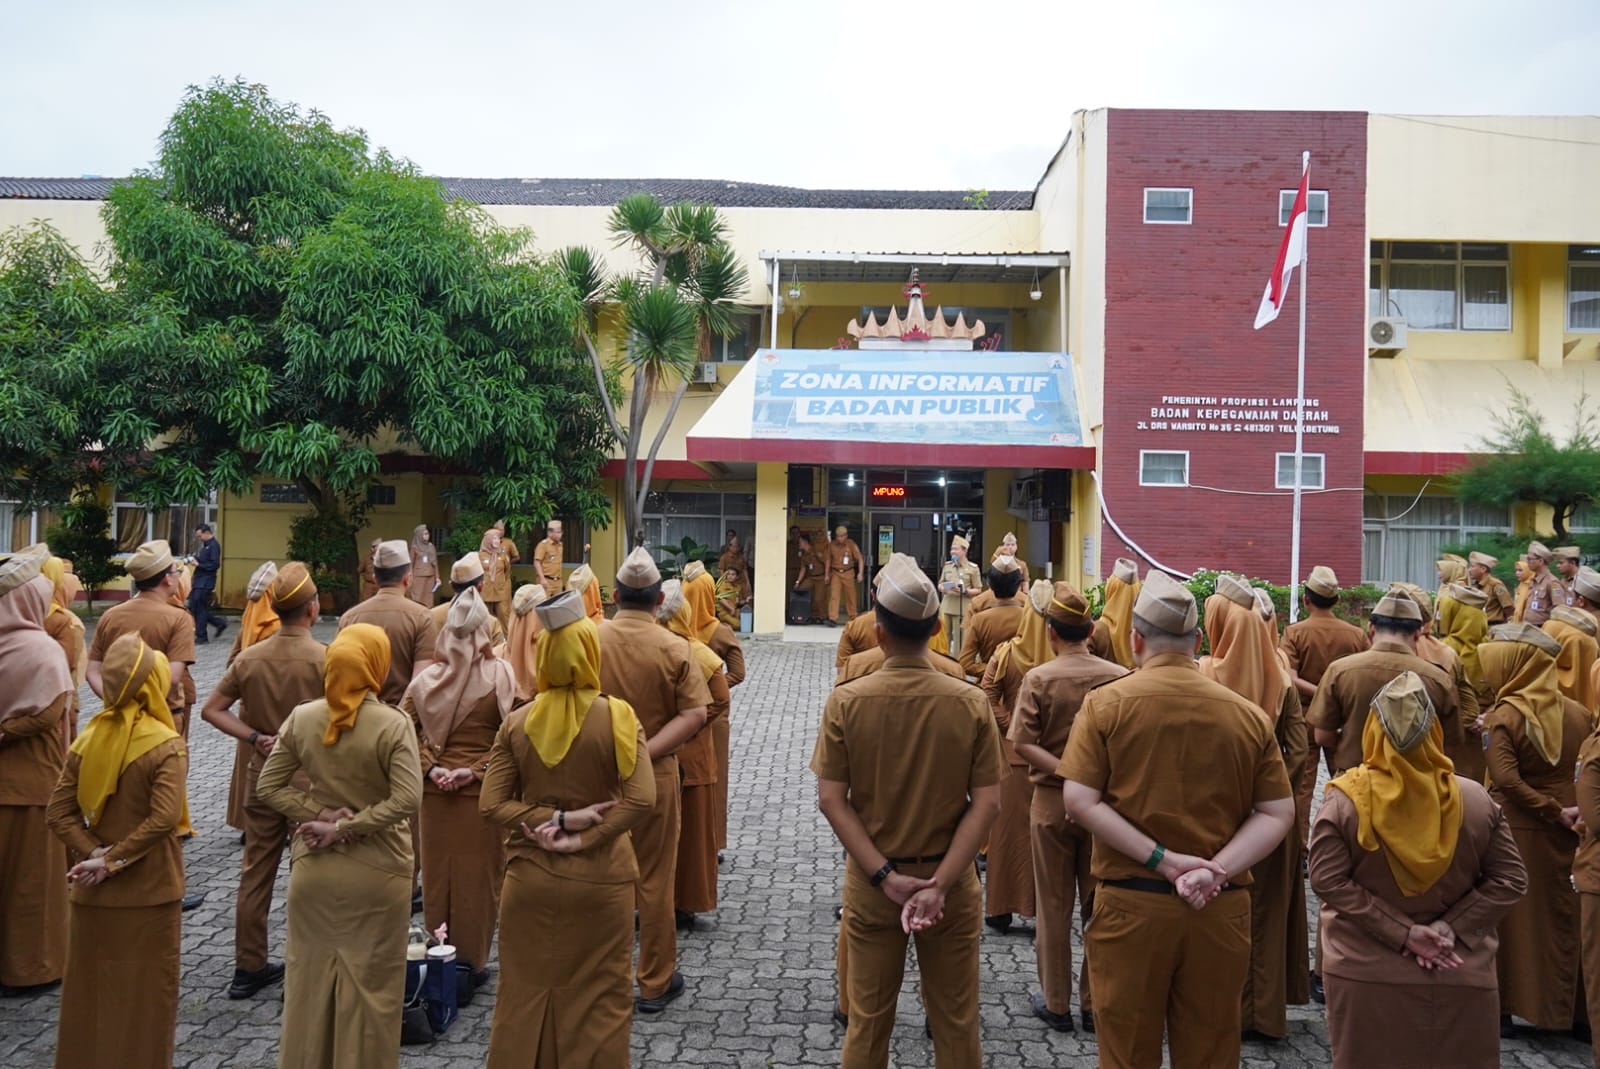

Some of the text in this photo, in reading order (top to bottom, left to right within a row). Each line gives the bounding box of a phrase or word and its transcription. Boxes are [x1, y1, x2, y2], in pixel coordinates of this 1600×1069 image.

[780, 372, 1049, 393] ZONA INFORMATIF
[807, 398, 1022, 416] BADAN PUBLIK
[1162, 396, 1217, 405] PEMERINTAH
[1221, 398, 1268, 406] PROPINSI
[1151, 408, 1189, 418] BADAN
[1197, 409, 1278, 420] KEPEGAWAIAN
[873, 487, 905, 496] MPUNG
